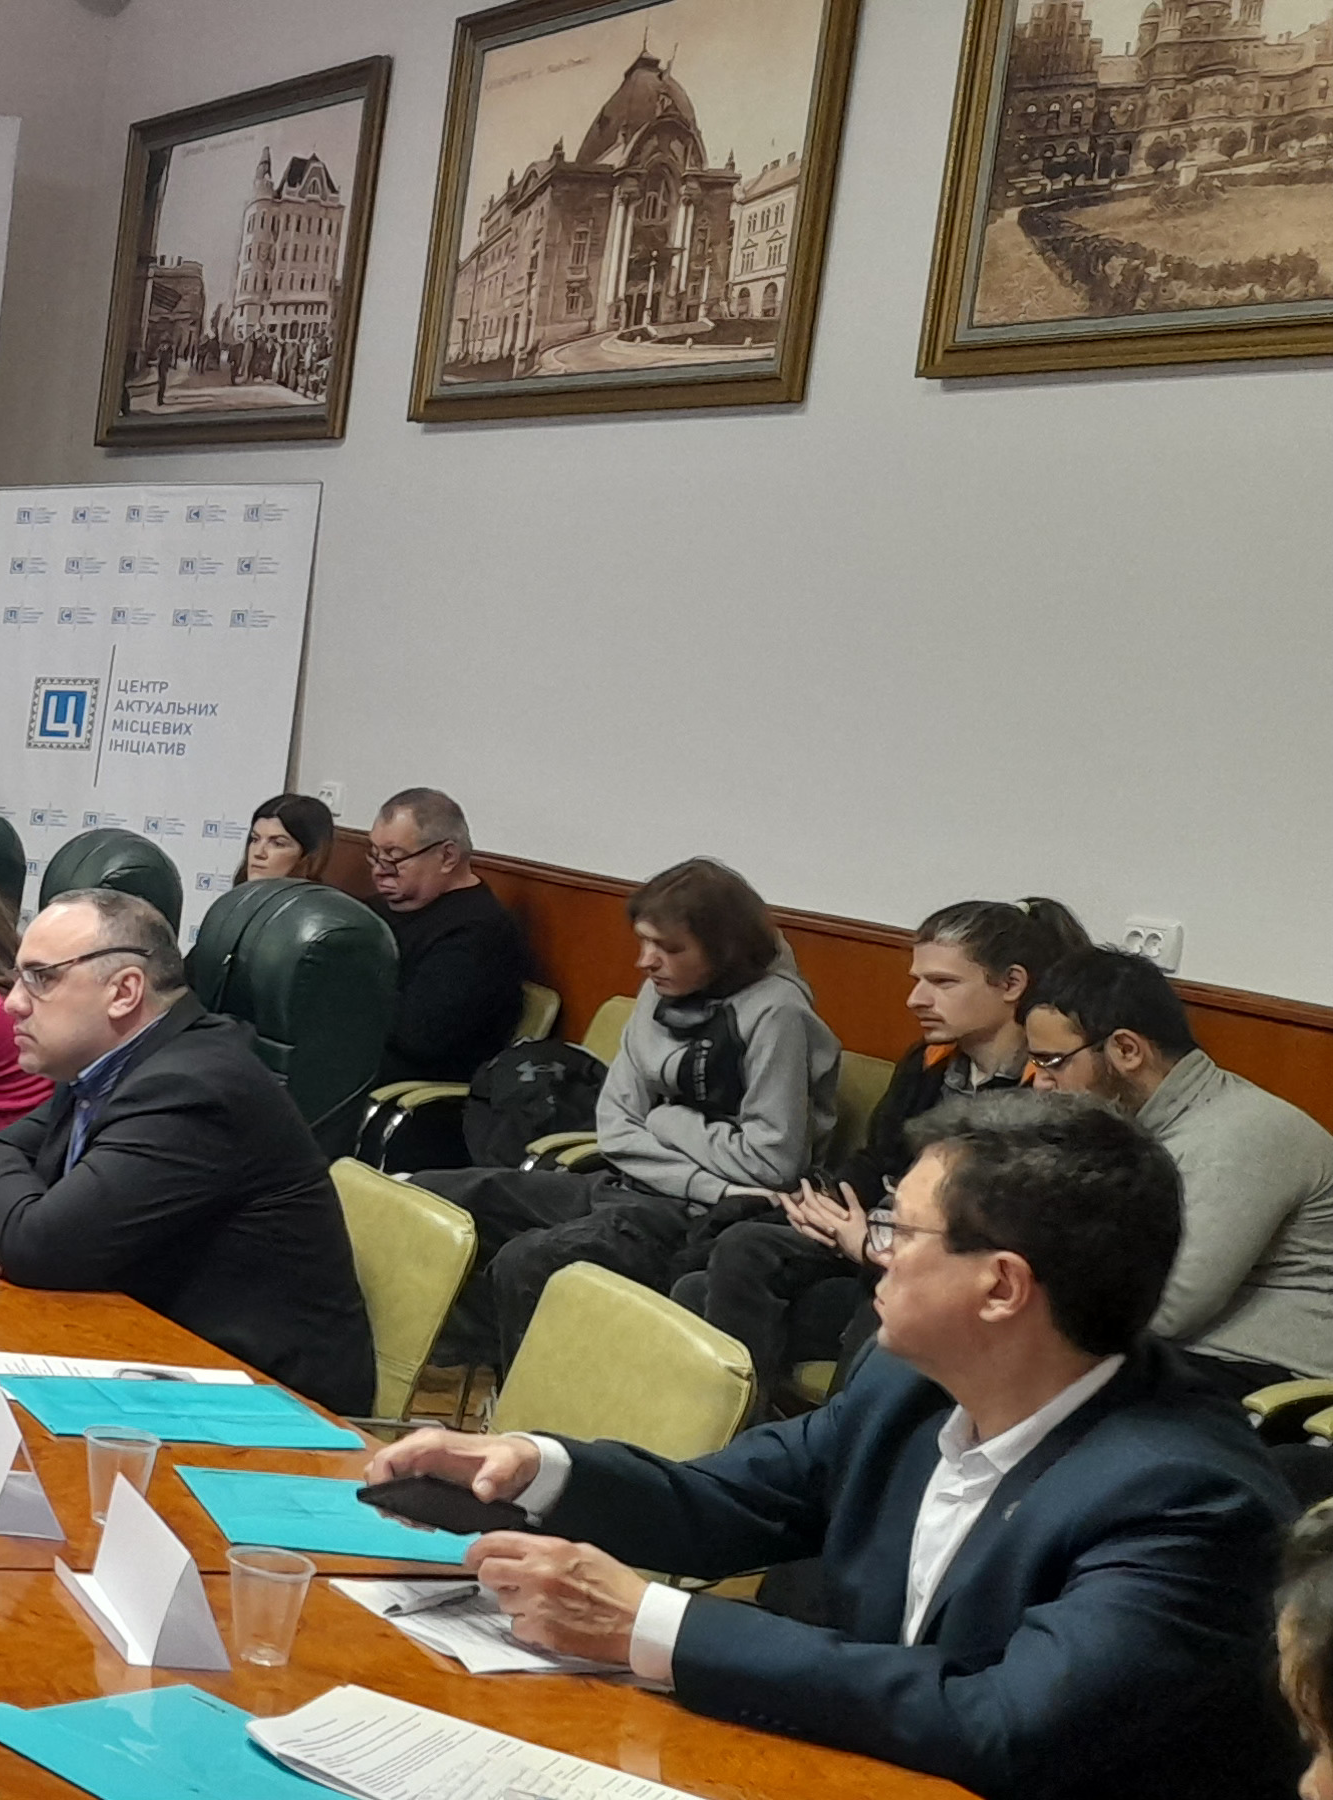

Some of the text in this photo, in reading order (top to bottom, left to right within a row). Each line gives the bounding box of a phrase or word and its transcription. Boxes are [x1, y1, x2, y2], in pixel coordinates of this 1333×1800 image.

[117, 679, 169, 695] ЦЕНТР
[113, 699, 219, 717] АКТУАЛЬНИХ
[111, 719, 193, 736] МІСЦЕВИХ
[108, 738, 187, 757] ІНІЦІАТИВ
